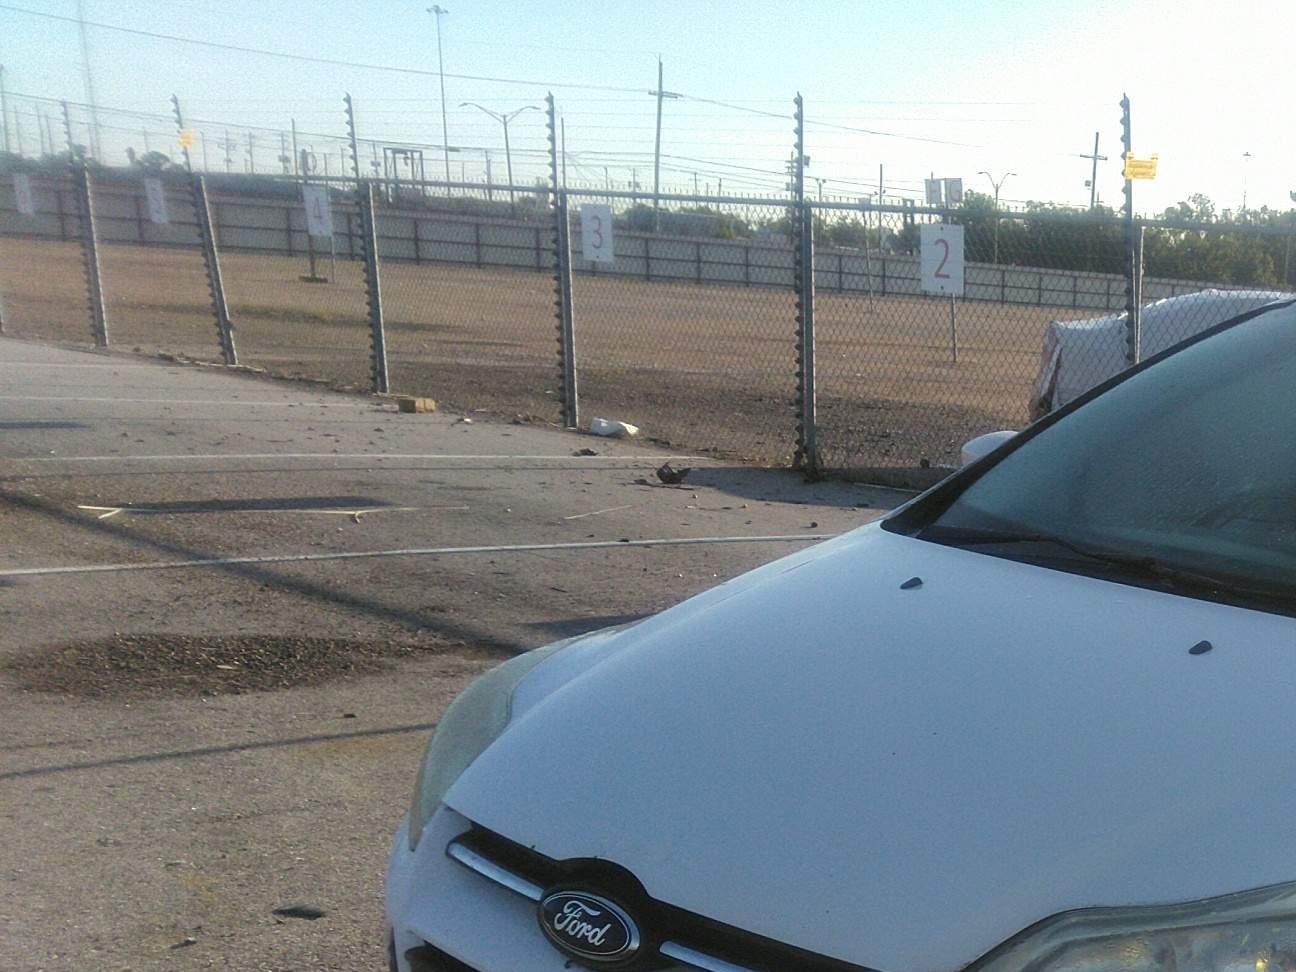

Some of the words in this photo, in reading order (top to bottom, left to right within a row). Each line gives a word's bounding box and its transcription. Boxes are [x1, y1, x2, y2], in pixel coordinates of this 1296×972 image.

[591, 215, 603, 249] 3
[934, 238, 951, 279] 2
[554, 900, 612, 946] Ford
